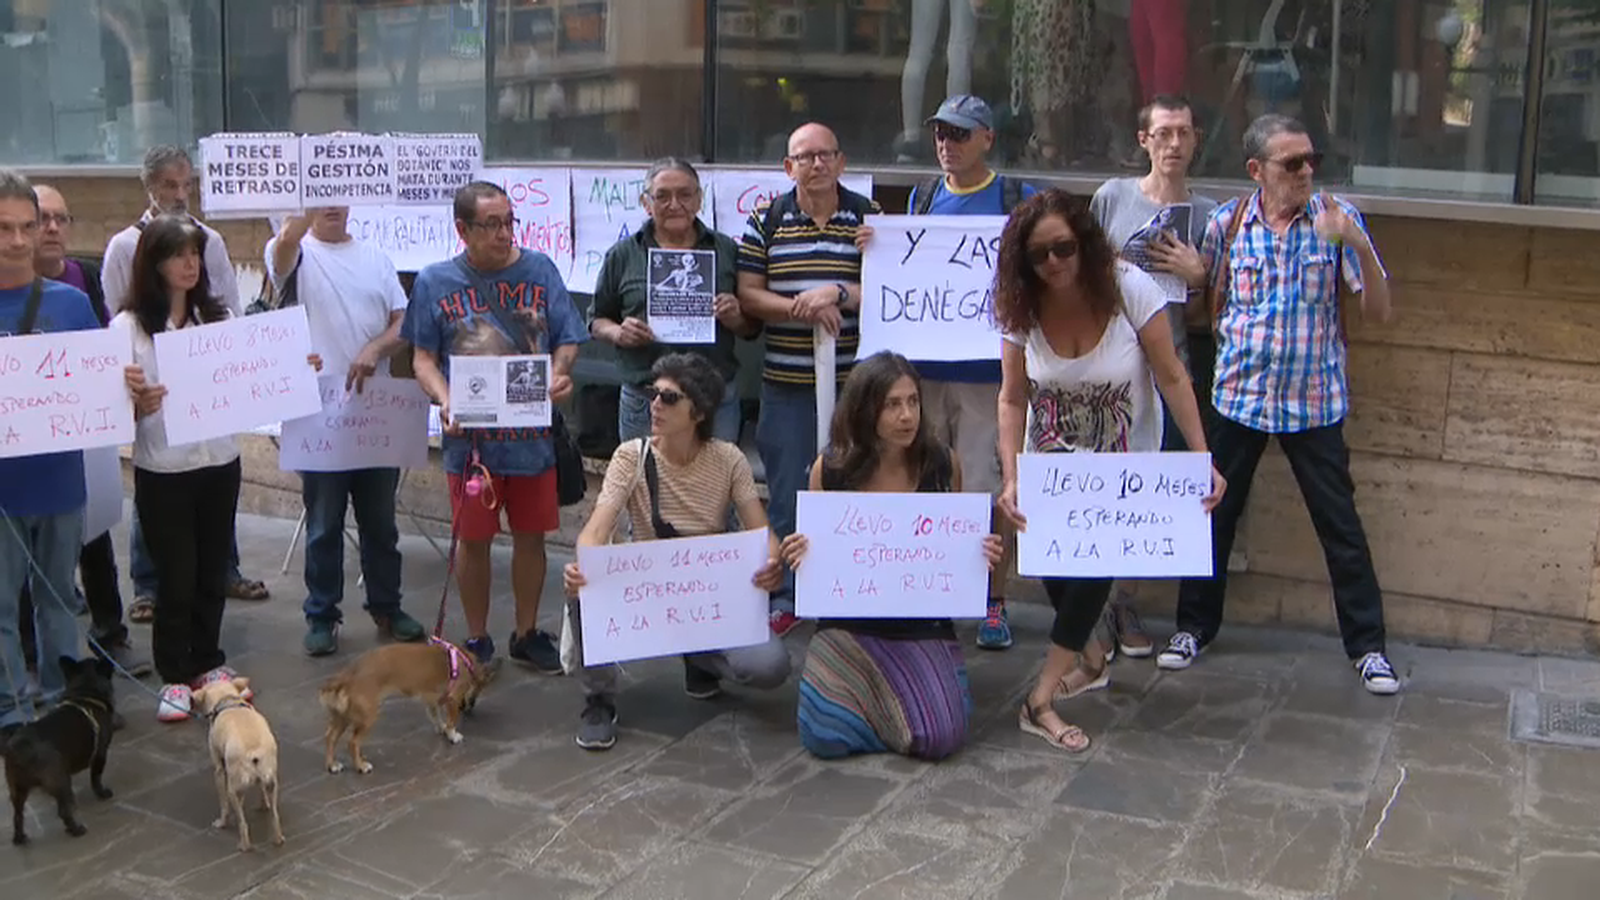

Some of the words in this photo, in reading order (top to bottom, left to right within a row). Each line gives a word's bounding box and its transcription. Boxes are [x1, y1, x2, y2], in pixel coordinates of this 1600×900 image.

[225, 145, 282, 159] TRECE
[314, 141, 384, 159] PÉSIMA
[397, 145, 409, 157] EL
[209, 162, 269, 177] MESES
[276, 162, 298, 176] DE
[308, 159, 389, 178] GESTIÓN
[450, 159, 471, 171] NOS
[212, 180, 296, 194] RETRASO
[397, 174, 426, 186] MATA
[428, 173, 474, 186] DURANTE
[305, 183, 393, 198] INCOMPETENCIA
[397, 188, 430, 200] MESES
[433, 188, 440, 199] Y
[901, 228, 926, 265] Y
[188, 332, 233, 357] LLEVO
[189, 402, 200, 419] A
[211, 397, 231, 410] LA
[1042, 467, 1105, 497] LLEVO
[1117, 469, 1144, 500] 10
[1154, 473, 1207, 497] MESES
[834, 504, 893, 536] LLEVO
[912, 514, 934, 536] 10
[938, 517, 982, 537] MESES
[1067, 508, 1174, 531] ESPERANDO
[853, 543, 946, 569] ESPERANDO
[1046, 539, 1062, 562] A
[1073, 541, 1100, 559] LA
[606, 553, 653, 575] LLEVO
[670, 550, 691, 568] 11
[697, 549, 740, 568] MESES
[623, 579, 718, 604] ESPERANDO
[831, 578, 844, 599] A
[857, 578, 879, 596] LA
[606, 617, 621, 638] A
[631, 614, 650, 631] LA
